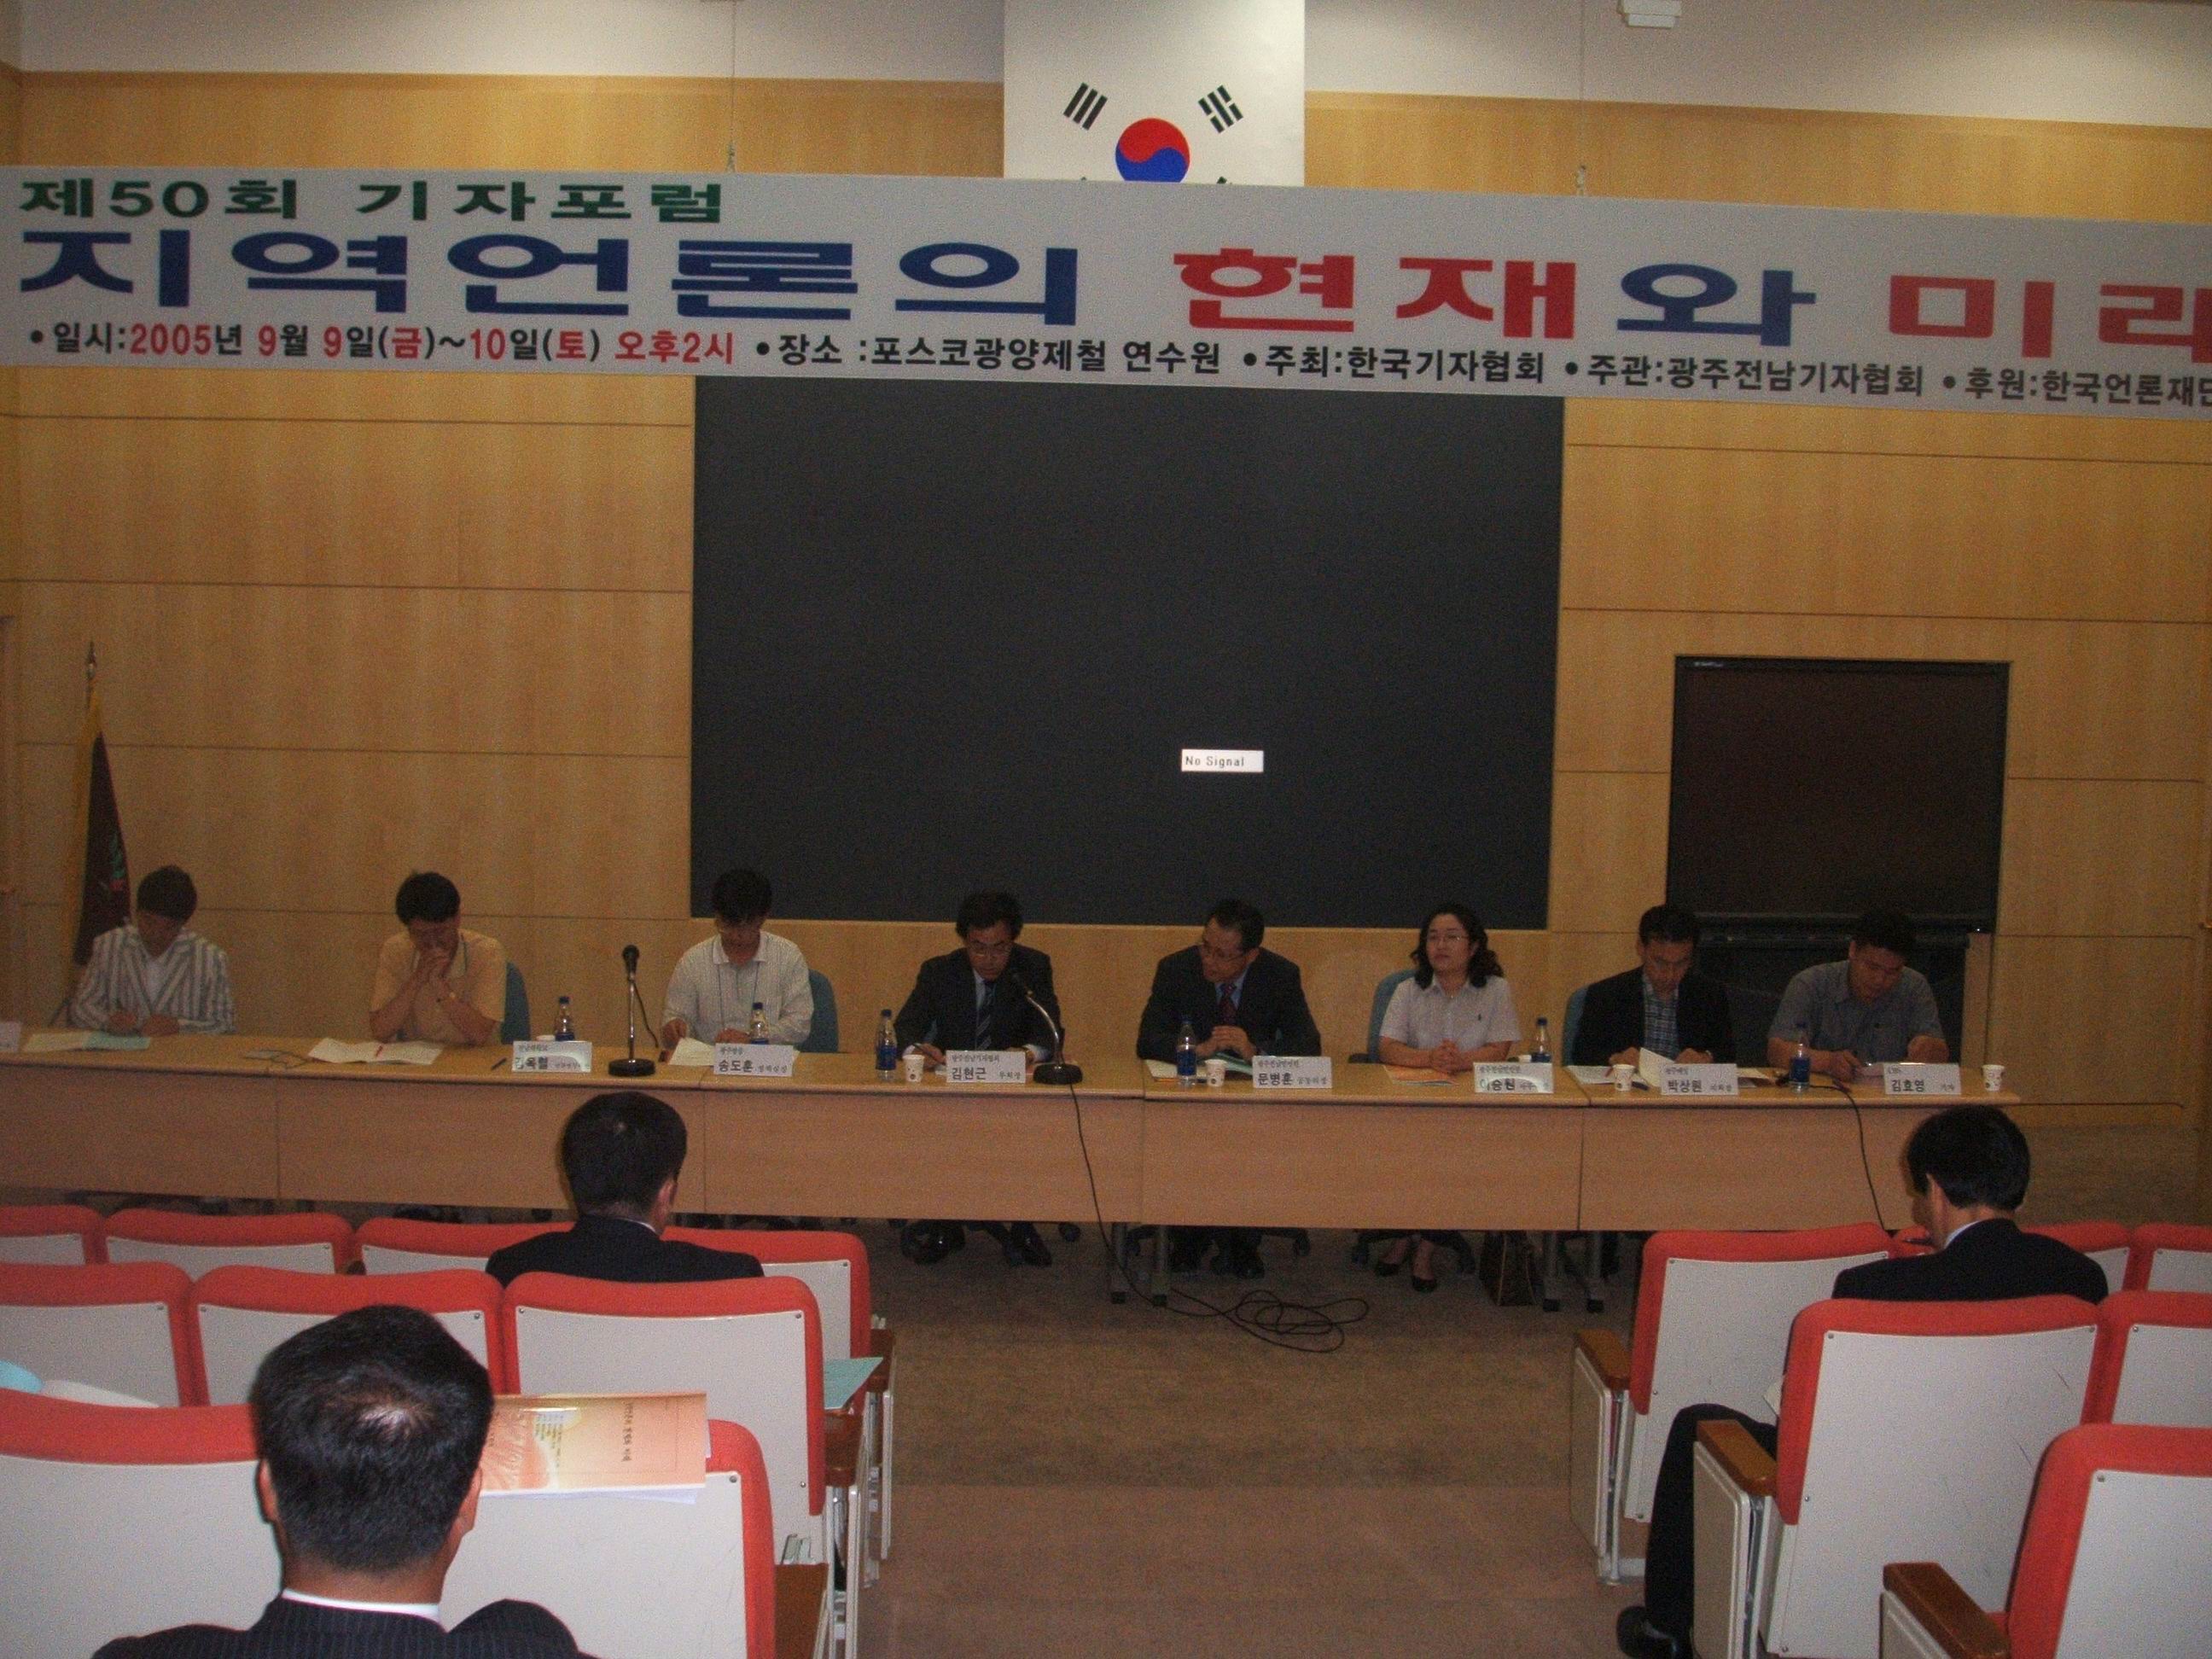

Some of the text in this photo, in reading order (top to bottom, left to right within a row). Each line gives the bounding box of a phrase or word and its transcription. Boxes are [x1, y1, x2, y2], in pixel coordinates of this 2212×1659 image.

[20, 178, 721, 223] 제50회 기자포럼
[20, 229, 1078, 326] 지역언론의
[1173, 247, 1817, 346] 현재와
[53, 321, 243, 357] 일시:2005년
[258, 323, 309, 359] 9월
[323, 324, 601, 362] 9일(금)~10일(토)
[614, 330, 734, 365] 오후2시
[1122, 341, 1220, 375] 연수원
[1266, 345, 1544, 384] 주최:한국기자협회
[1587, 354, 1924, 397] 주관:광주전남기자협회
[1185, 755, 1245, 769] No Signal
[951, 1067, 987, 1081] 김현근
